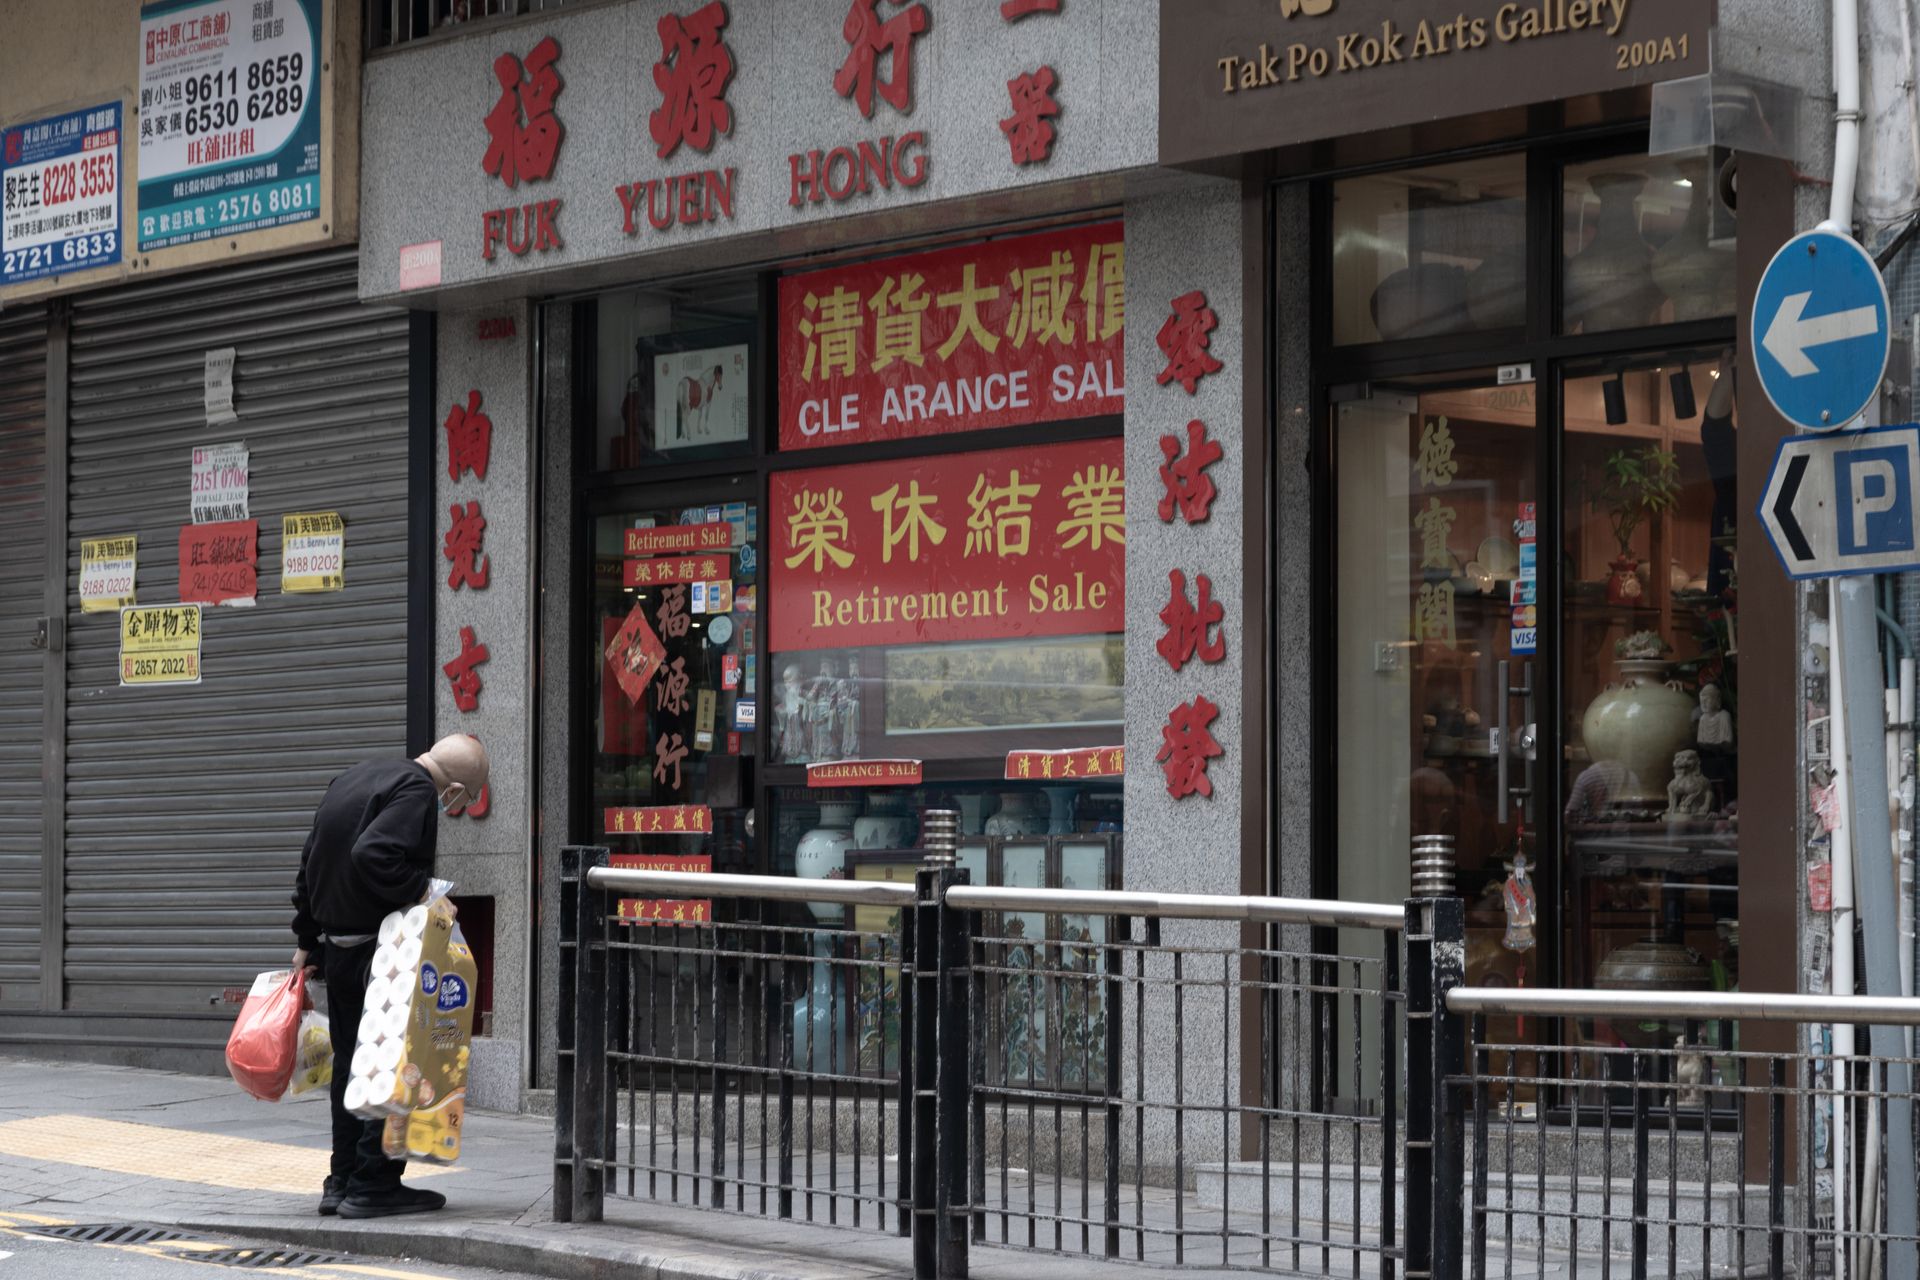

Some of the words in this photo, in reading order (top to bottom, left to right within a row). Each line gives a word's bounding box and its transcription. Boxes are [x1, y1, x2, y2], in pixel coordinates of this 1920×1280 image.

[189, 38, 231, 57] COMMERCIAL
[1218, 45, 1278, 93] Tak
[1289, 42, 1328, 82] Po
[1337, 21, 1402, 70] Kok
[1412, 17, 1486, 60] Arts
[1496, 0, 1630, 42] Gallery
[1615, 33, 1690, 71] 200A1
[185, 66, 238, 106] 9611
[247, 52, 303, 92] 8659
[1000, 0, 1062, 165] 器
[185, 97, 239, 137] 6530
[246, 83, 303, 123] 6289
[43, 161, 76, 207] 8228
[80, 152, 114, 198] 3553
[481, 199, 563, 260] FUK
[615, 167, 736, 235] YUEN
[787, 131, 928, 207] HONG
[218, 193, 262, 223] 2576
[269, 182, 312, 213] 8081
[3, 243, 53, 275] 2721
[63, 231, 116, 262] 6833
[798, 393, 860, 436] CLE
[881, 370, 1029, 424] ARANCE
[193, 468, 219, 492] 2151
[220, 466, 247, 487] 0706
[784, 463, 1125, 573] 榮休結業
[1850, 458, 1897, 548] P
[628, 529, 696, 551] Retirement
[701, 526, 728, 545] Sale
[286, 556, 308, 574] 9188
[311, 554, 340, 572] 0202
[635, 559, 718, 582] 榮休結業
[82, 580, 104, 596] 9188
[107, 577, 131, 594] 0202
[811, 580, 1008, 628] Retirement
[1028, 572, 1107, 614] Sale
[135, 658, 158, 676] 2857
[161, 657, 185, 675] 2022
[653, 583, 691, 790] 福源行
[740, 706, 754, 718] VISA
[812, 763, 883, 778] CLEARANCE
[889, 762, 918, 776] SALE
